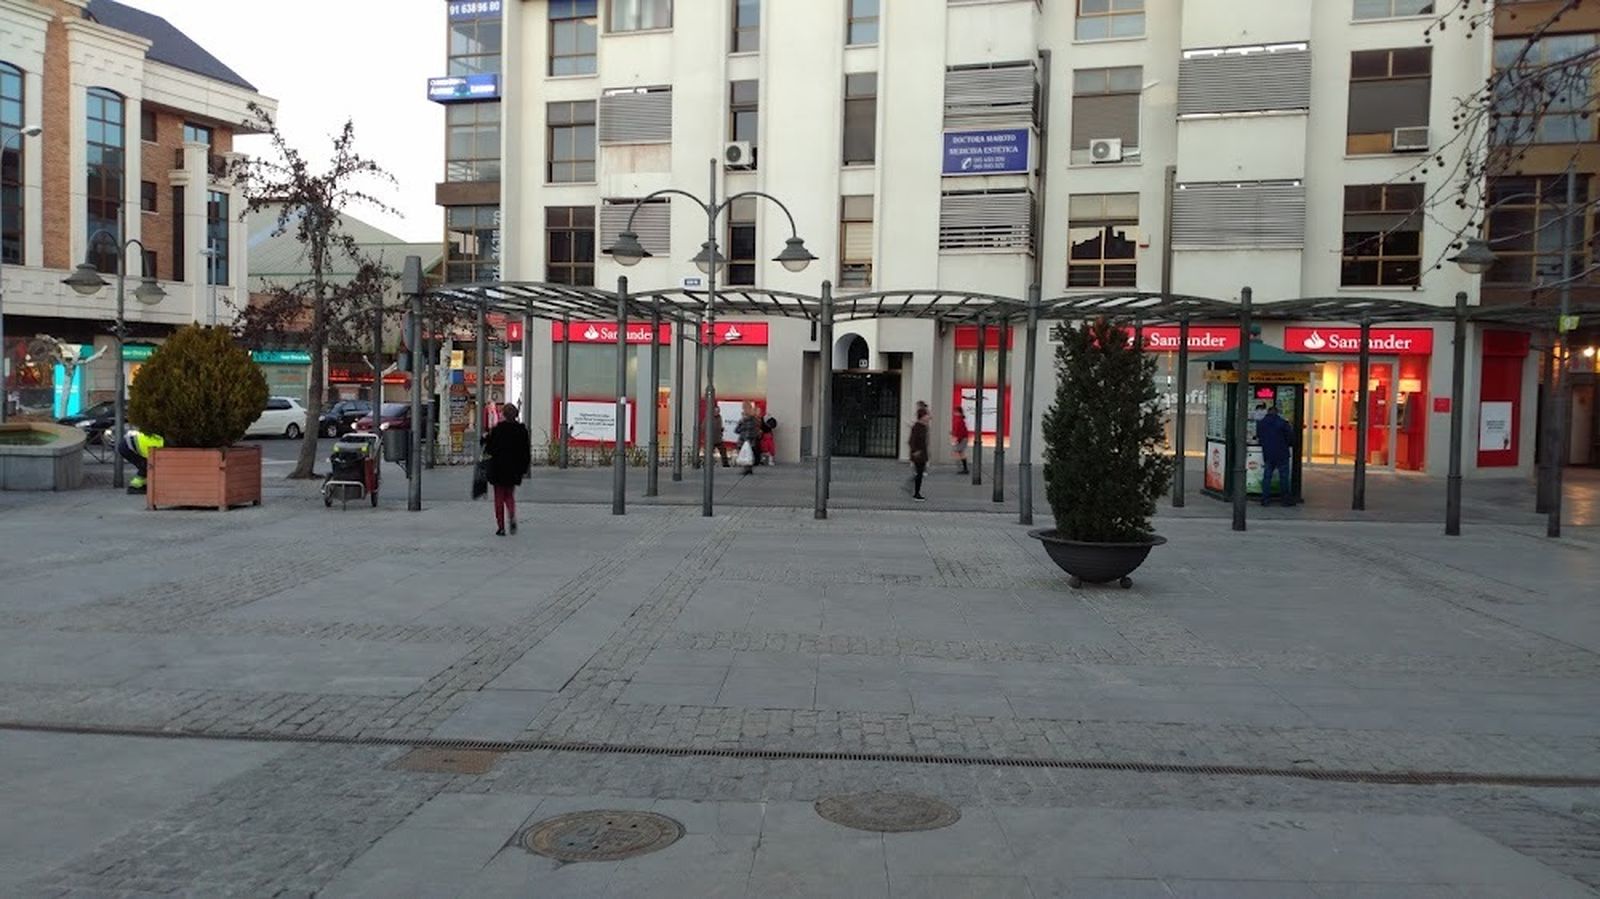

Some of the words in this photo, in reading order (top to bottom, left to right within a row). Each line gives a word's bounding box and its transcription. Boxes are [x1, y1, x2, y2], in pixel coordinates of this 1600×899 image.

[450, 5, 459, 15] 91
[952, 136, 985, 144] DOCTORA
[986, 134, 1017, 142] MAROTO
[949, 147, 983, 155] MEDICINA
[600, 327, 655, 340] Sannde
[1150, 332, 1227, 347] Santnder
[1328, 334, 1413, 350] Sannder
